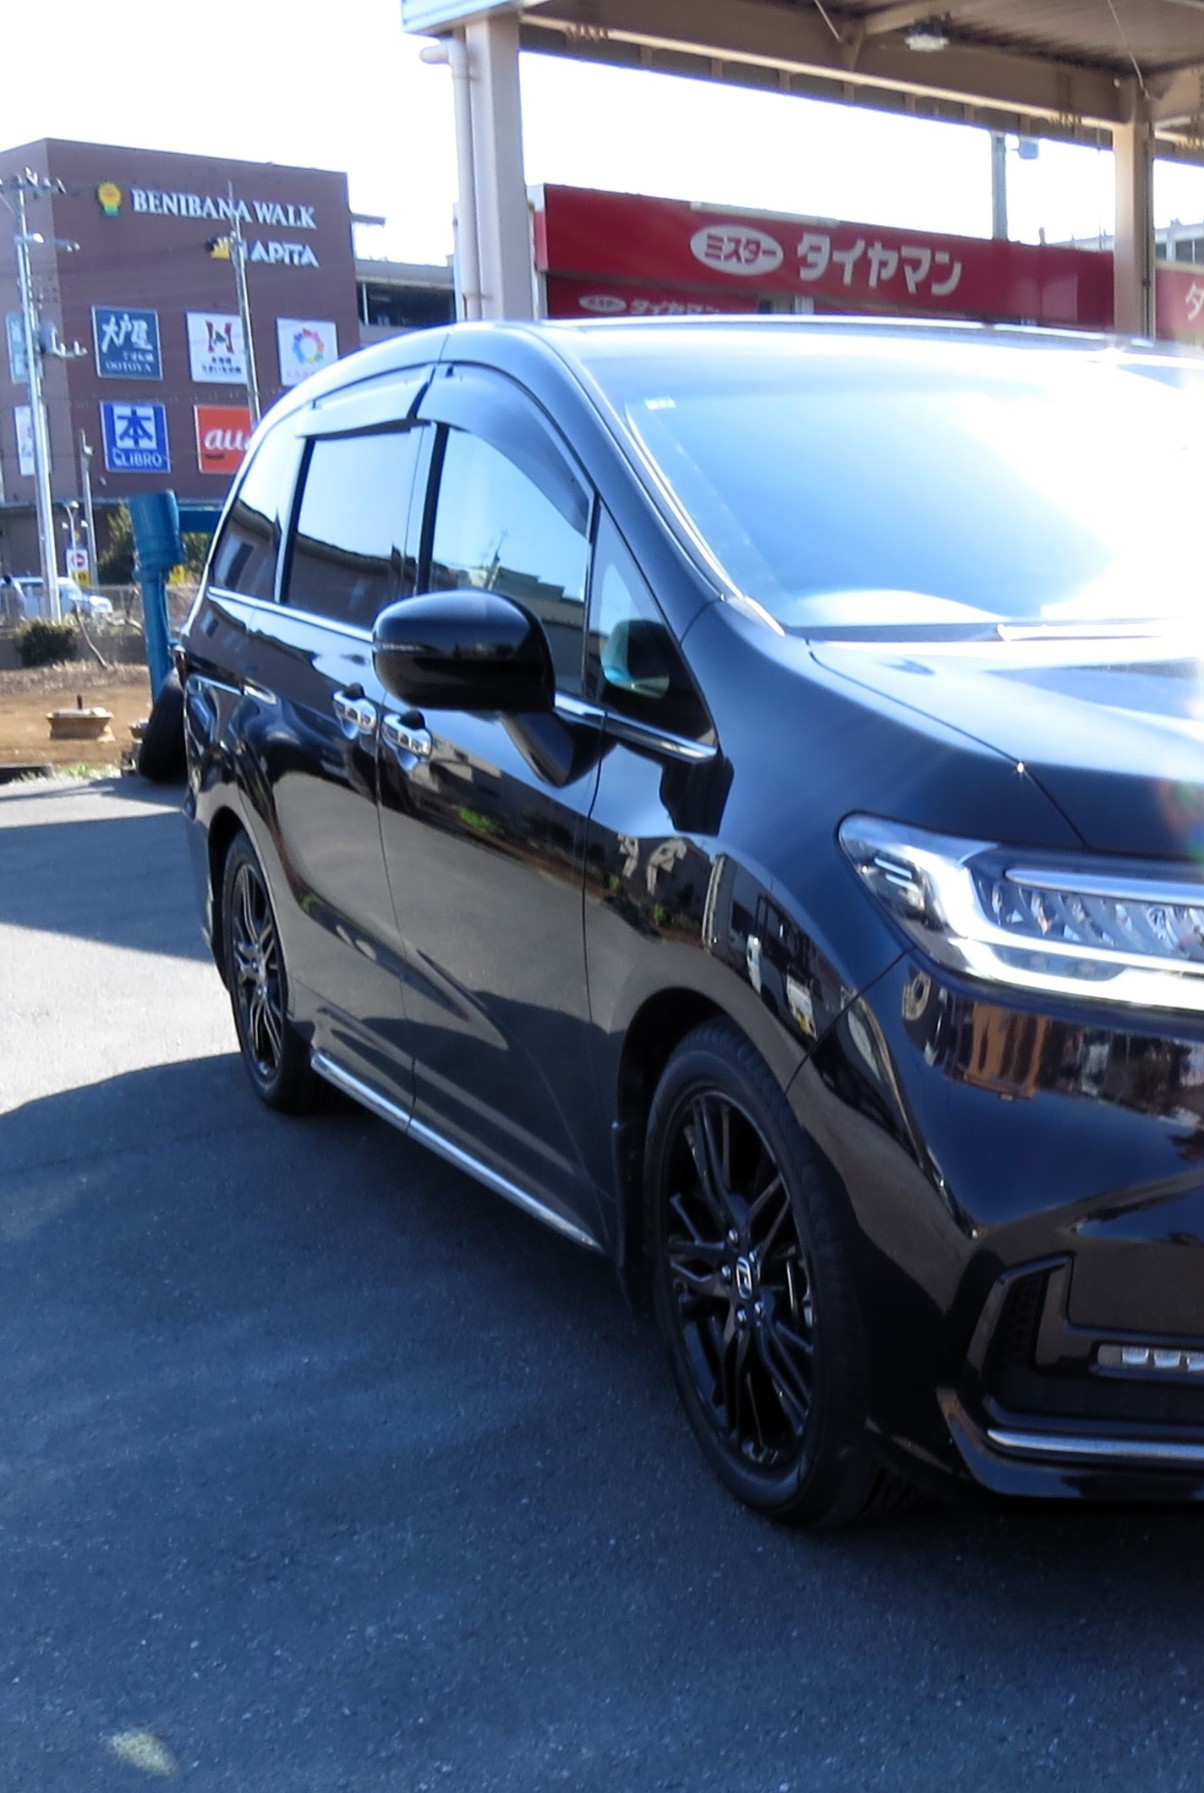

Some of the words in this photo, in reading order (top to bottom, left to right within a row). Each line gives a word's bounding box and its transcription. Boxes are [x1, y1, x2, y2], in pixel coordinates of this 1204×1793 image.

[131, 188, 254, 225] BENIBANA
[254, 201, 318, 231] WALK
[251, 240, 321, 269] APITA
[704, 233, 777, 265] ミスター
[797, 231, 962, 296] タイヤマン
[116, 407, 154, 447] 本
